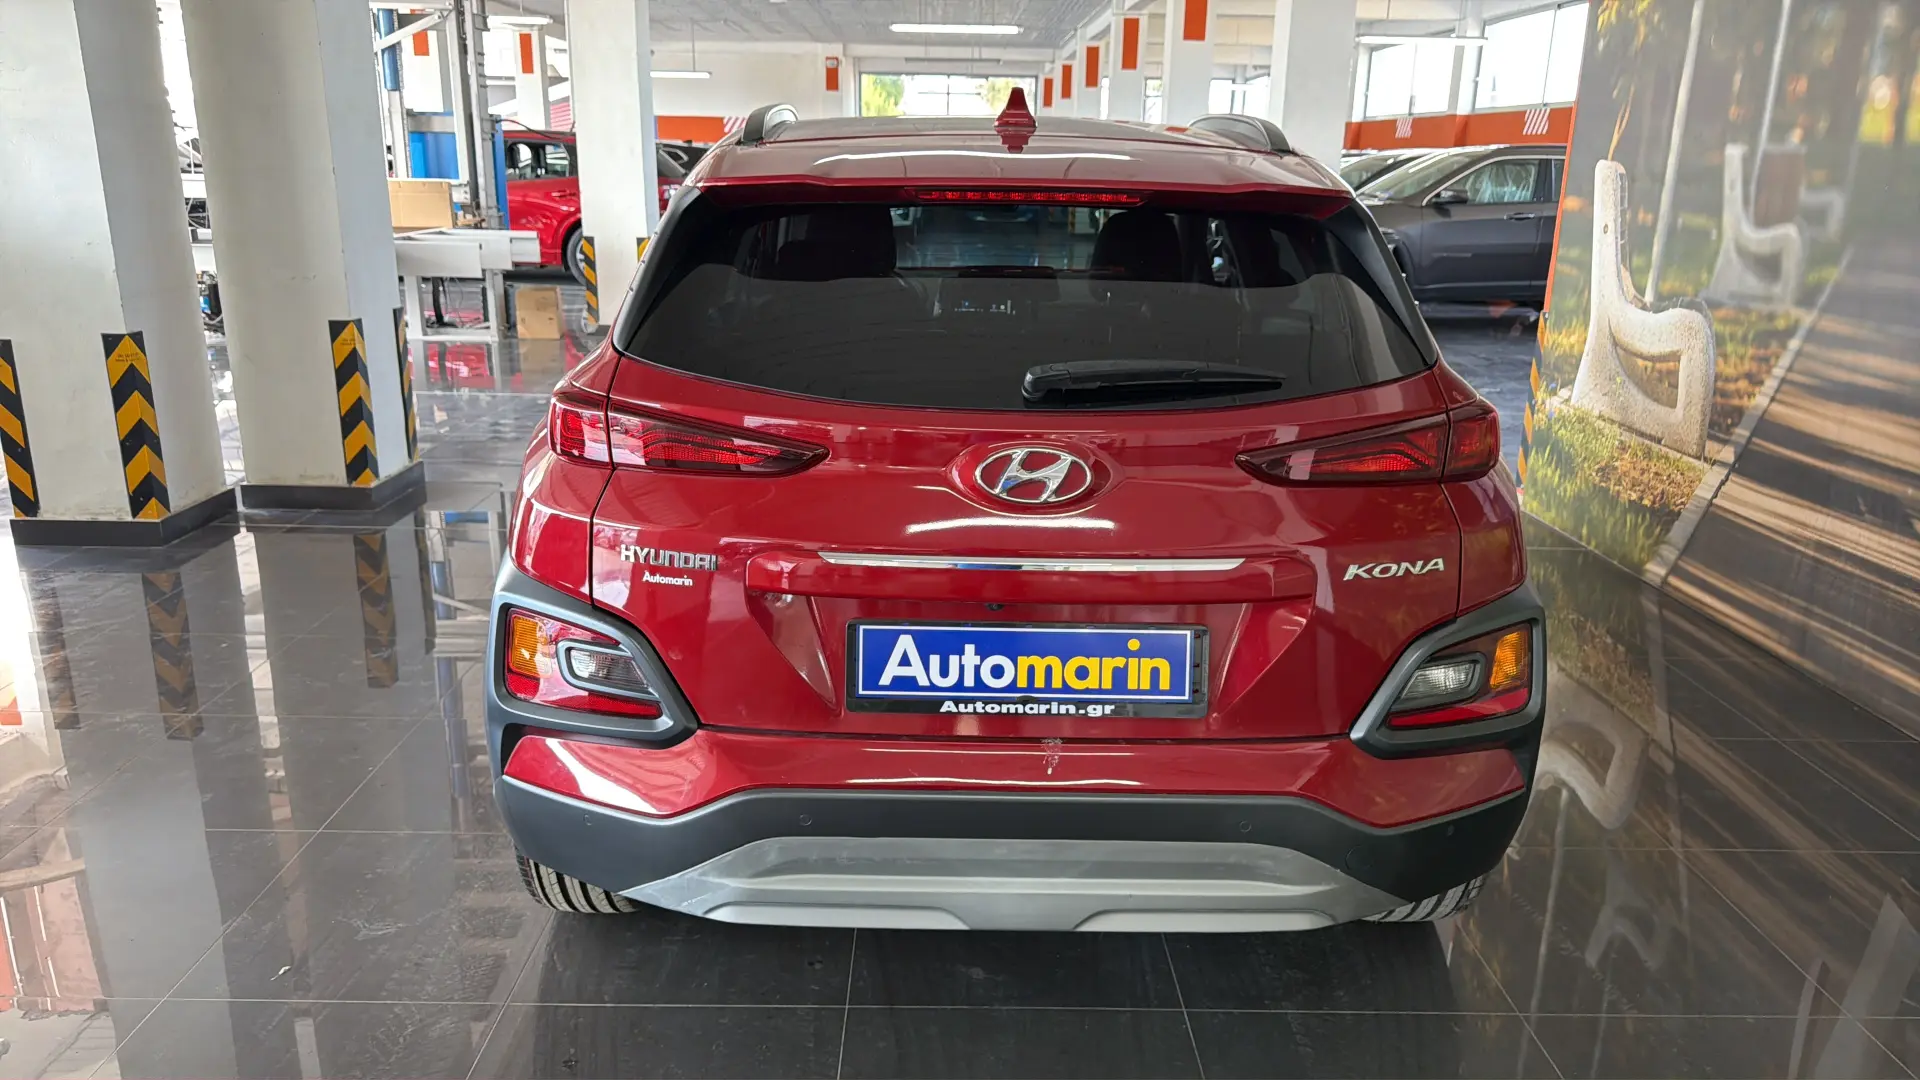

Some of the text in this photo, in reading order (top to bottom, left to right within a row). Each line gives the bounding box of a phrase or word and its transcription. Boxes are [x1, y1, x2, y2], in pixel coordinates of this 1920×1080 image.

[620, 544, 718, 571] HYUNDAI
[642, 570, 693, 587] Automarin
[1343, 558, 1445, 581] KONA
[878, 634, 1171, 691] Automarin
[940, 700, 1115, 717] Automarin.gr
